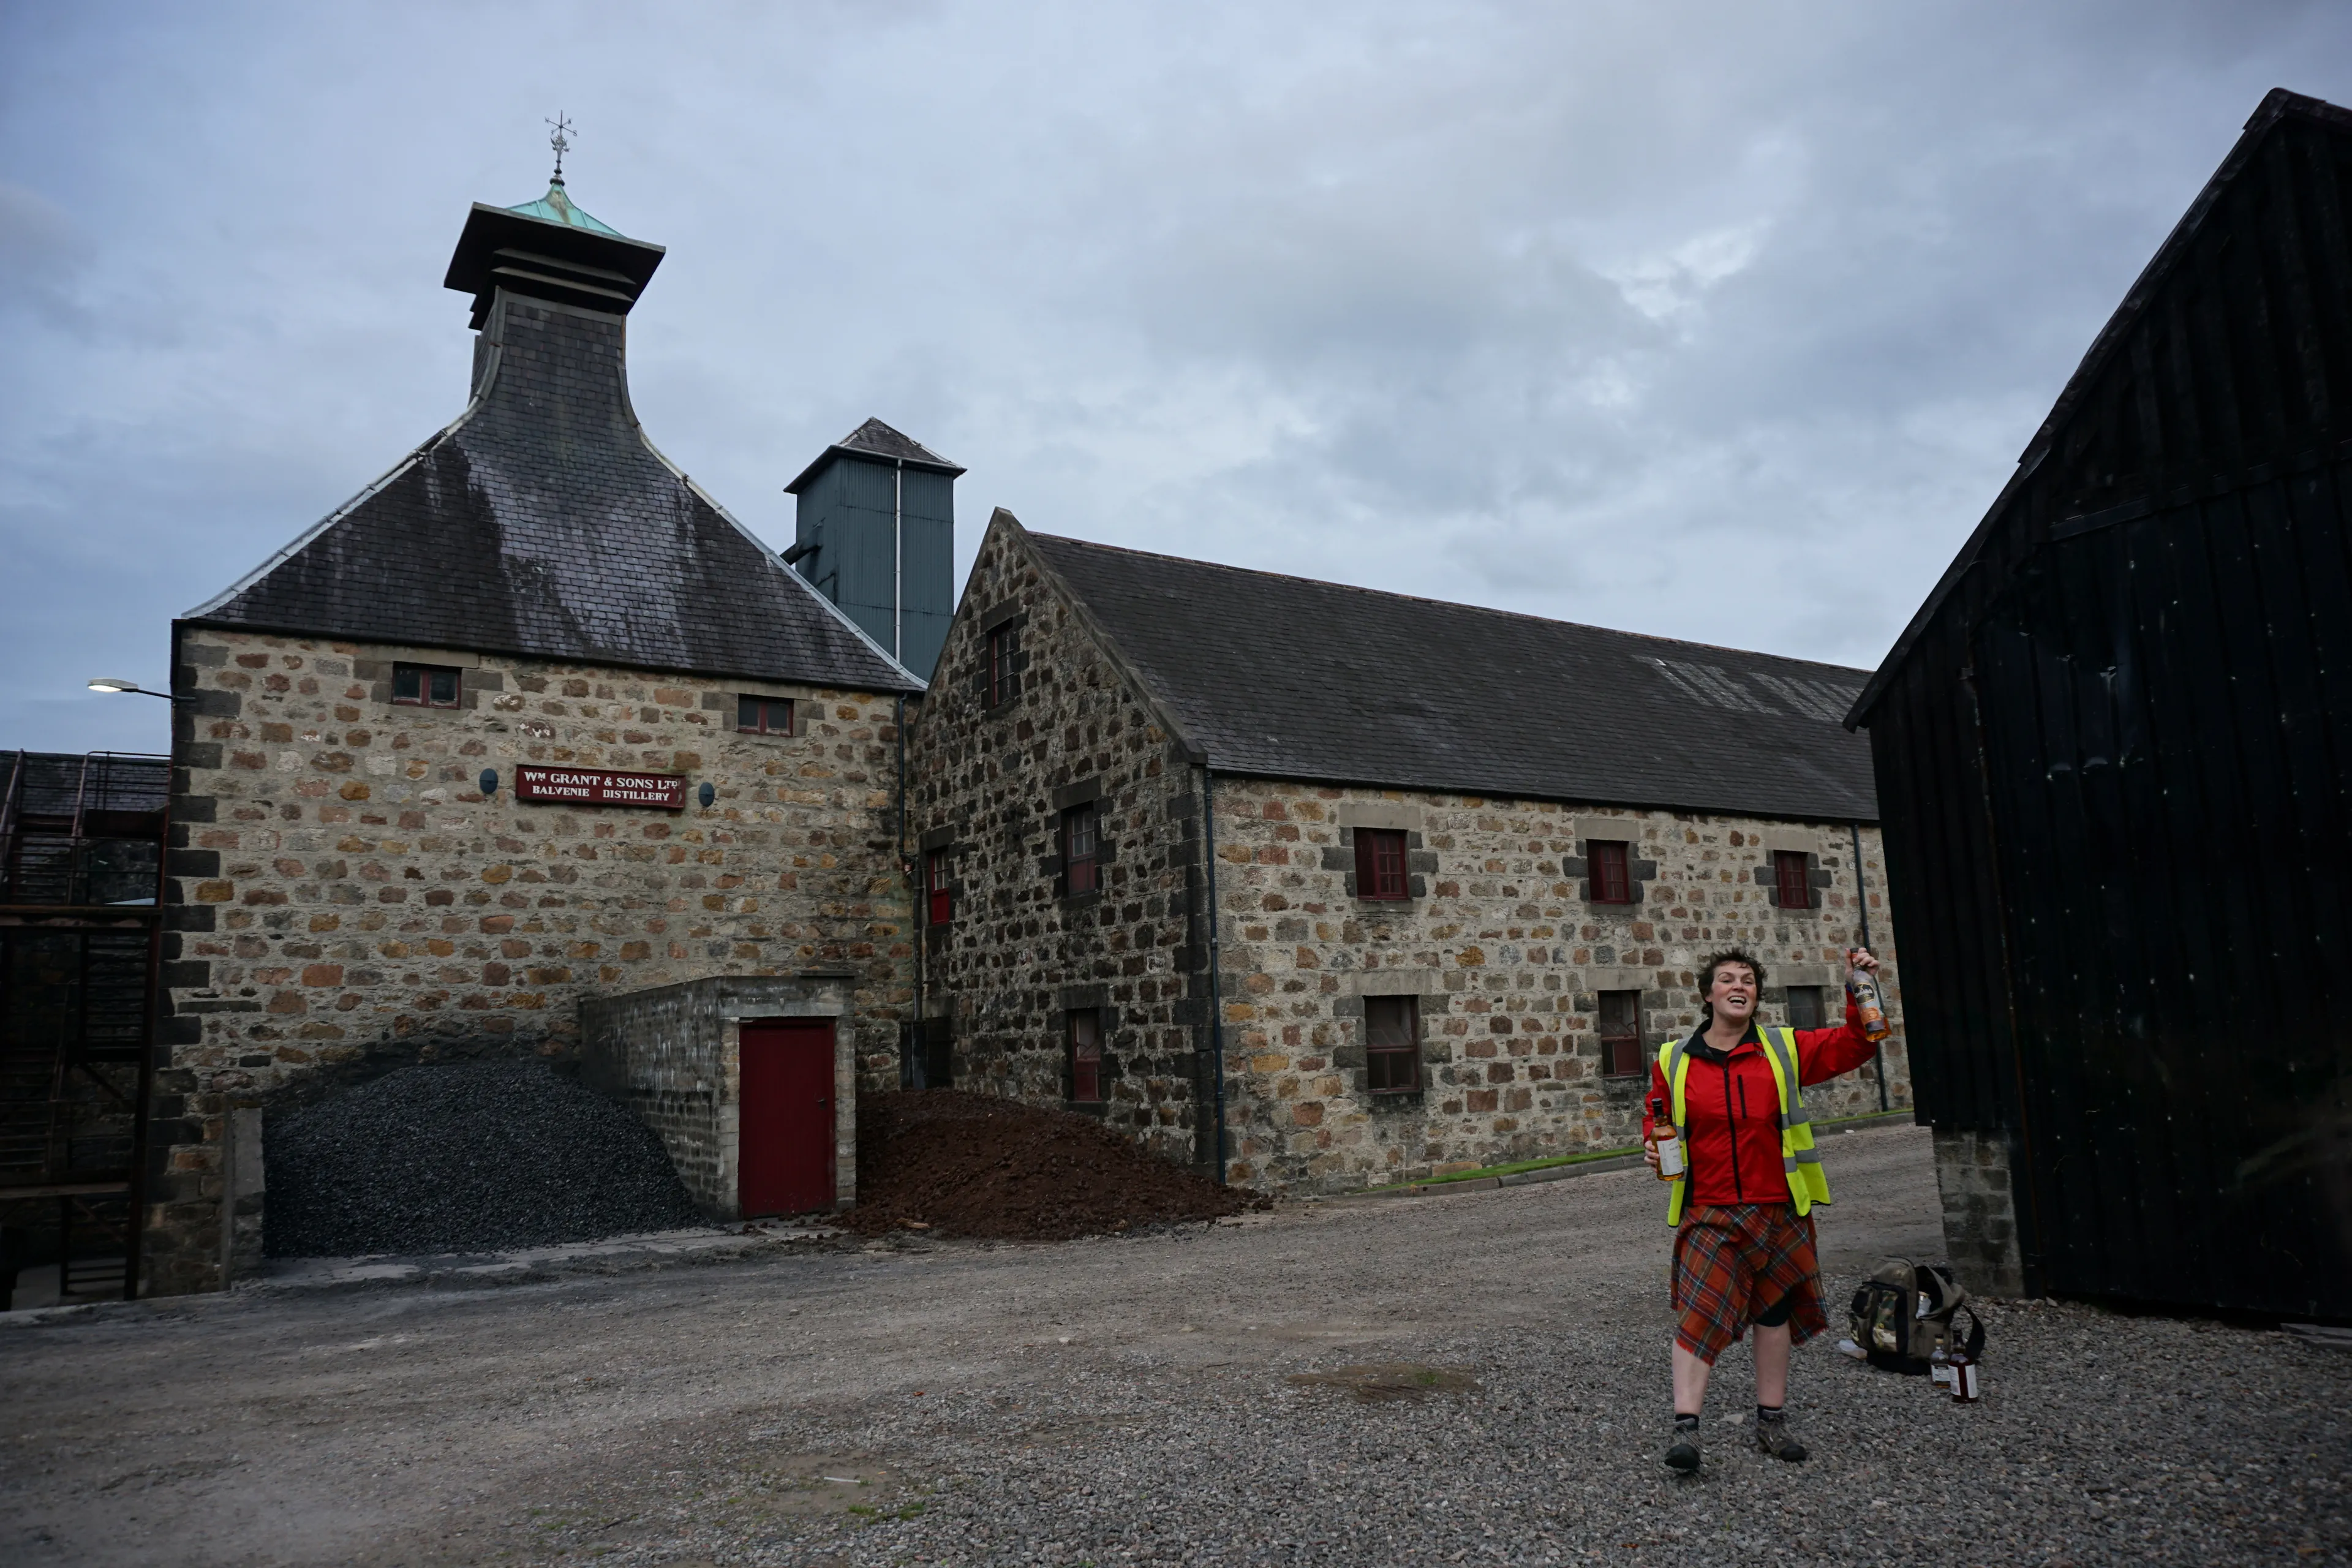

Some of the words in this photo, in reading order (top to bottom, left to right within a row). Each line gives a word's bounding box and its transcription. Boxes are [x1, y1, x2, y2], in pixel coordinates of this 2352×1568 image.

[551, 773, 600, 786] GRANT
[604, 777, 612, 786] &
[616, 777, 654, 789] SONS
[532, 785, 589, 796] BALVENIE
[603, 789, 669, 801] DISTILLERY
